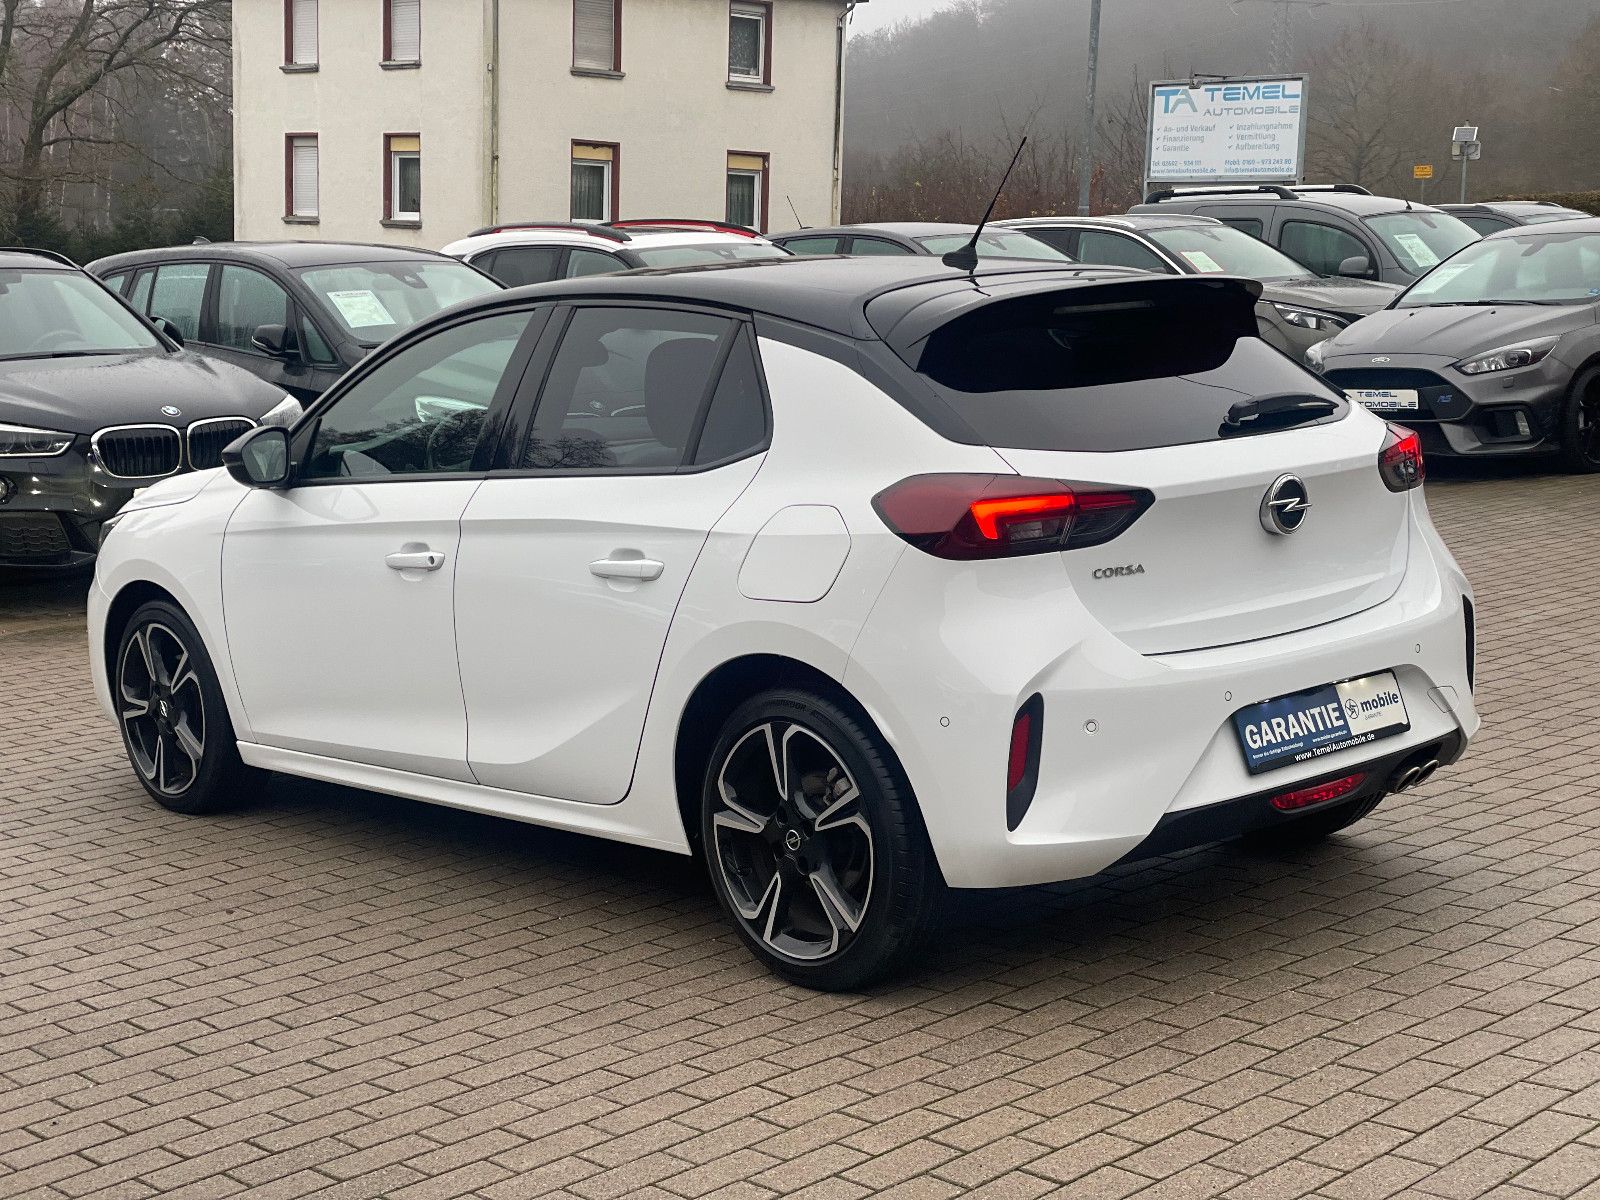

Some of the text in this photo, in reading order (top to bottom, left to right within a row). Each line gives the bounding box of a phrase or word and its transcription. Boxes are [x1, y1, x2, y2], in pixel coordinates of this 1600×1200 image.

[1204, 84, 1300, 102] TEMEL
[1190, 124, 1216, 132] Verkauf
[1236, 123, 1293, 131] Inzahlungnahme
[1162, 135, 1204, 143] Finanzierung
[1236, 133, 1276, 141] Vermittlung
[1162, 144, 1190, 152] Garantie
[1235, 143, 1280, 151] Aufbereitung
[1093, 564, 1146, 579] CORSA
[1360, 691, 1399, 712] mobile
[1244, 702, 1345, 750] GARANTIE
[1294, 732, 1375, 762] www.TemelAutomobile.de
